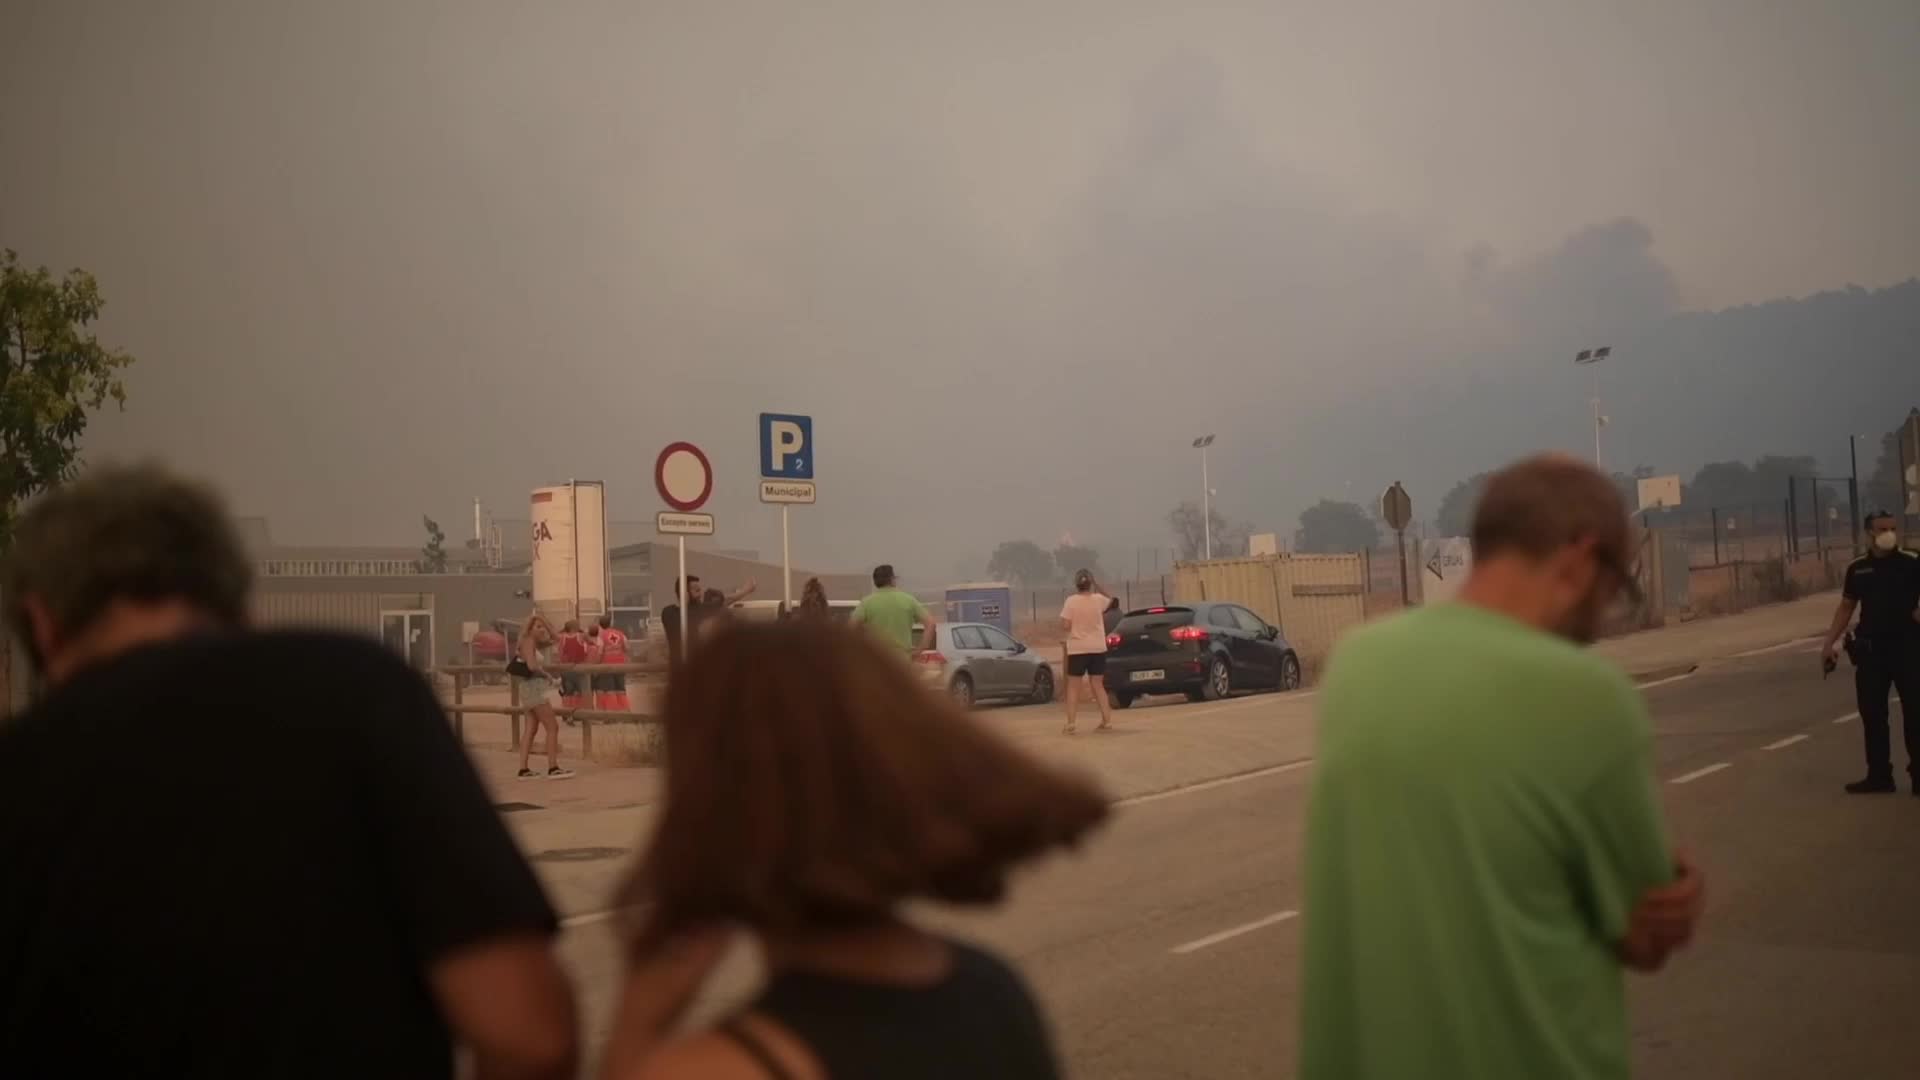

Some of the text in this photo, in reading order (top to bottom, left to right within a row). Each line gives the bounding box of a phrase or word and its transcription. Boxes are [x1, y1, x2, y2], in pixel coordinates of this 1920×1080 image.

[771, 420, 803, 471] P
[795, 458, 804, 471] 2
[765, 485, 812, 497] Municipal
